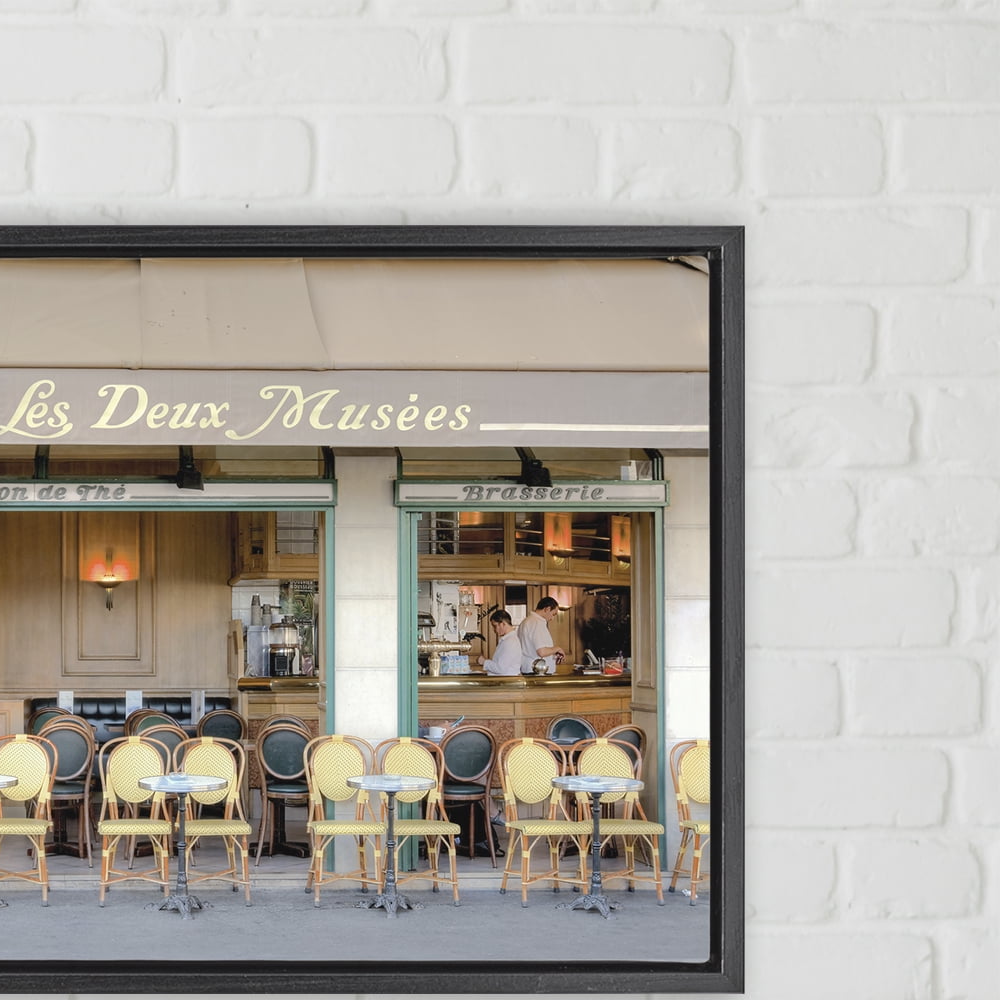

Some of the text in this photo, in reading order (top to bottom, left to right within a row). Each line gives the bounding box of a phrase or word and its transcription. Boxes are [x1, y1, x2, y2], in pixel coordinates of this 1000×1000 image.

[90, 384, 230, 430] Deux
[225, 385, 472, 440] Musées
[37, 484, 72, 501] de
[76, 484, 126, 501] Thé
[462, 485, 605, 501] Brasserie
